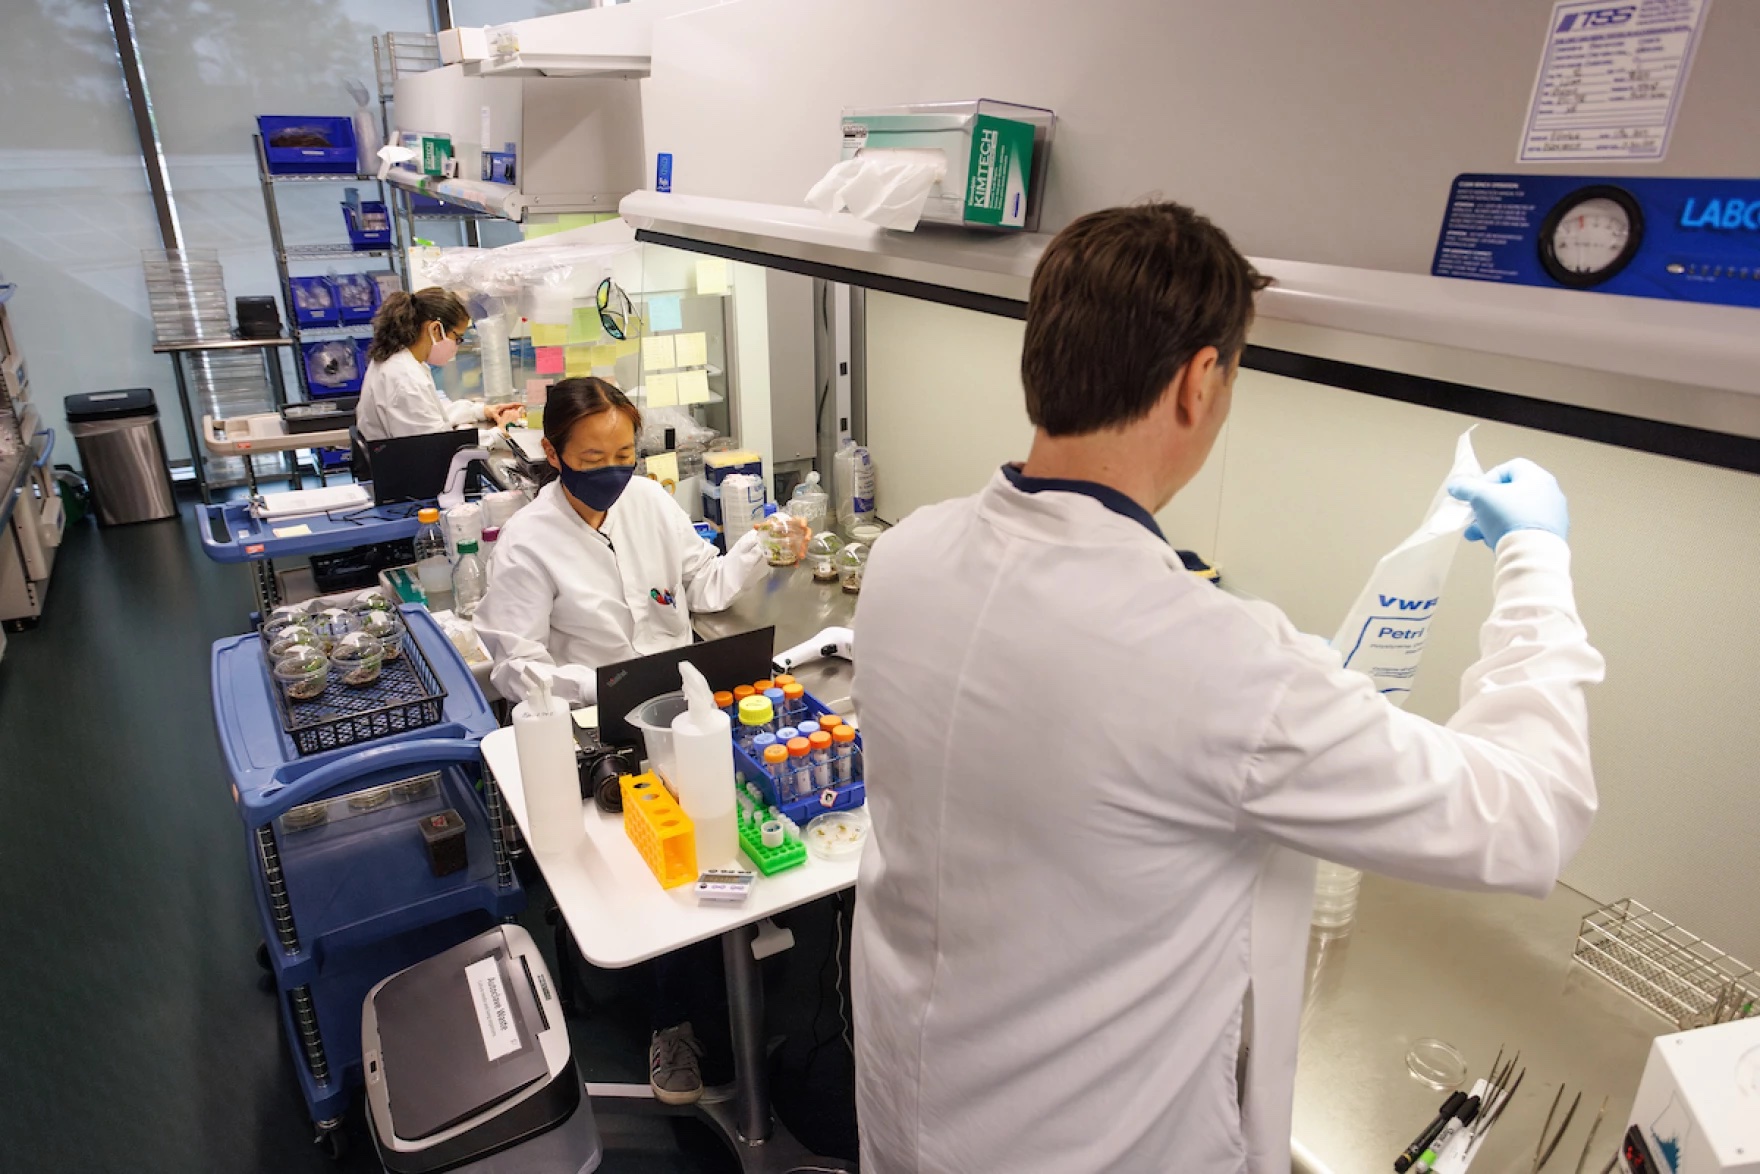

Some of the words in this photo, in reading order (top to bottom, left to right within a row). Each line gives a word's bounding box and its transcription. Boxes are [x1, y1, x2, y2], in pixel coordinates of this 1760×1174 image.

[1582, 6, 1637, 27] TSS
[974, 129, 993, 208] KIMTECH
[1681, 198, 1760, 229] LABC
[1378, 627, 1425, 640] Petri
[487, 977, 501, 1008] Autoclave
[497, 1008, 509, 1031] Waste
